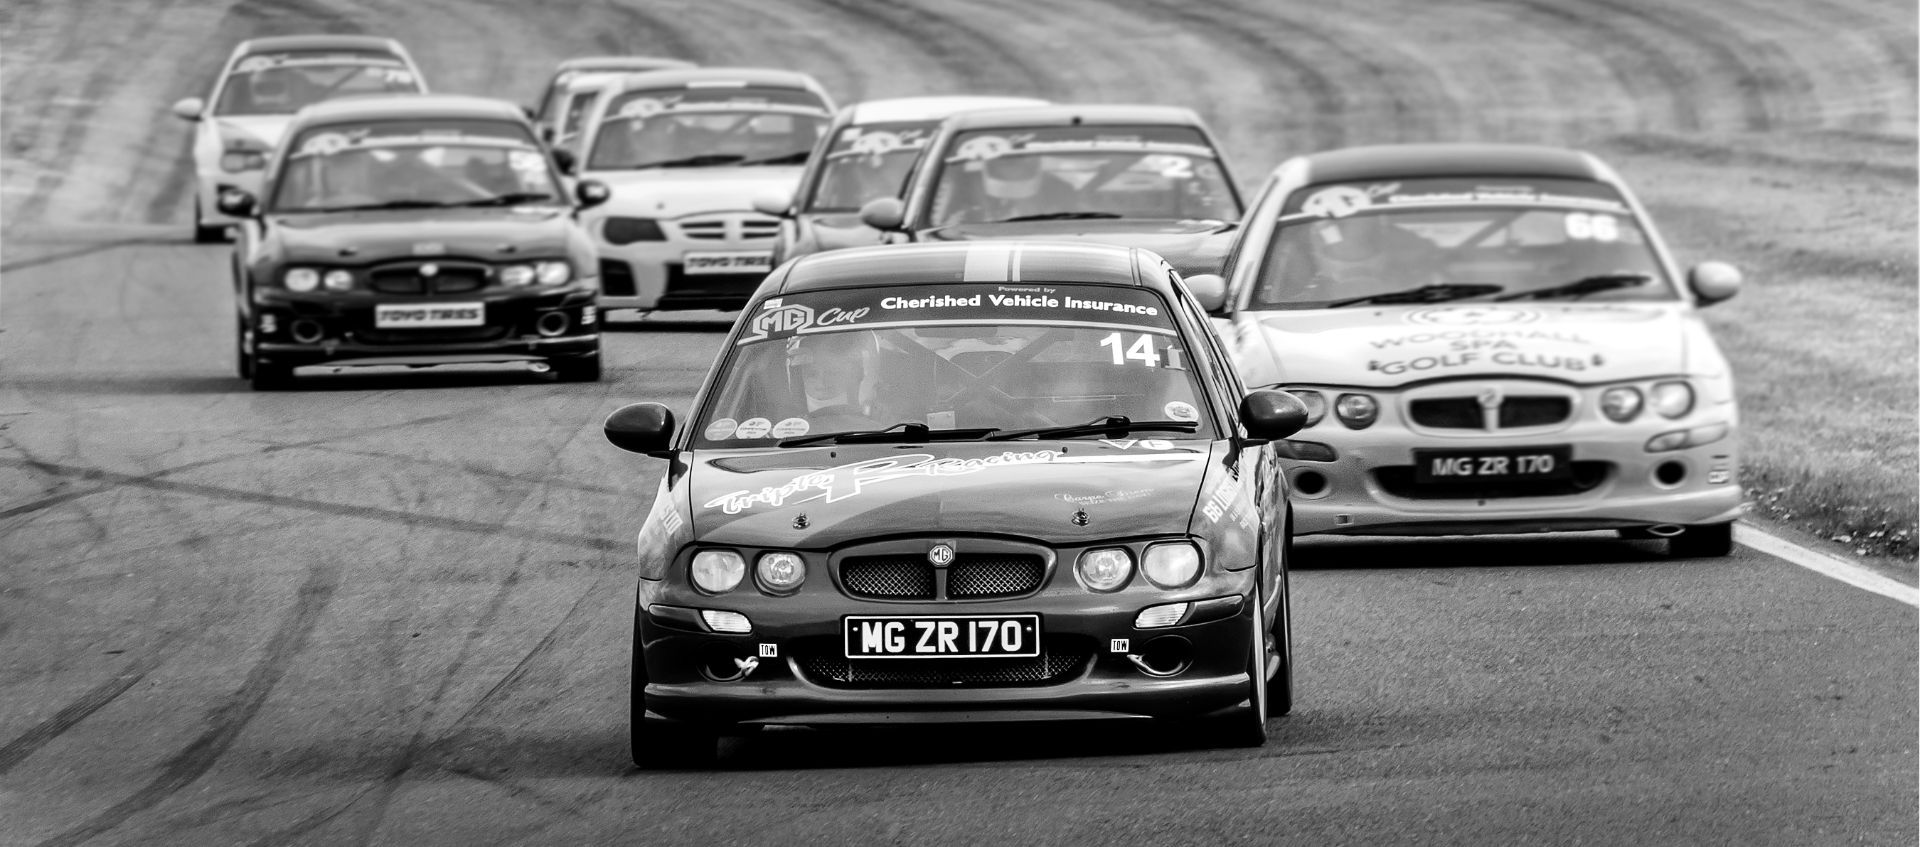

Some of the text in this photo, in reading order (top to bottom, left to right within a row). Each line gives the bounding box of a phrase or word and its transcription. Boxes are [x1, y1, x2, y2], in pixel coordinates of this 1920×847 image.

[1565, 212, 1618, 242] 66
[380, 308, 479, 321] TOYO TIRES
[881, 294, 1158, 316] Cherished Vehicle Insurance
[757, 306, 871, 334] MG Cup
[1100, 332, 1161, 367] 14
[1370, 330, 1590, 349] WOODHALL
[1449, 340, 1518, 351] SPA
[1380, 352, 1586, 375] GOLF CLUB
[1432, 455, 1554, 475] MG ZR 170
[930, 546, 952, 565] MG
[862, 620, 1022, 653] MG ZR 170
[1112, 639, 1127, 651] TOW
[760, 645, 775, 656] TOW
